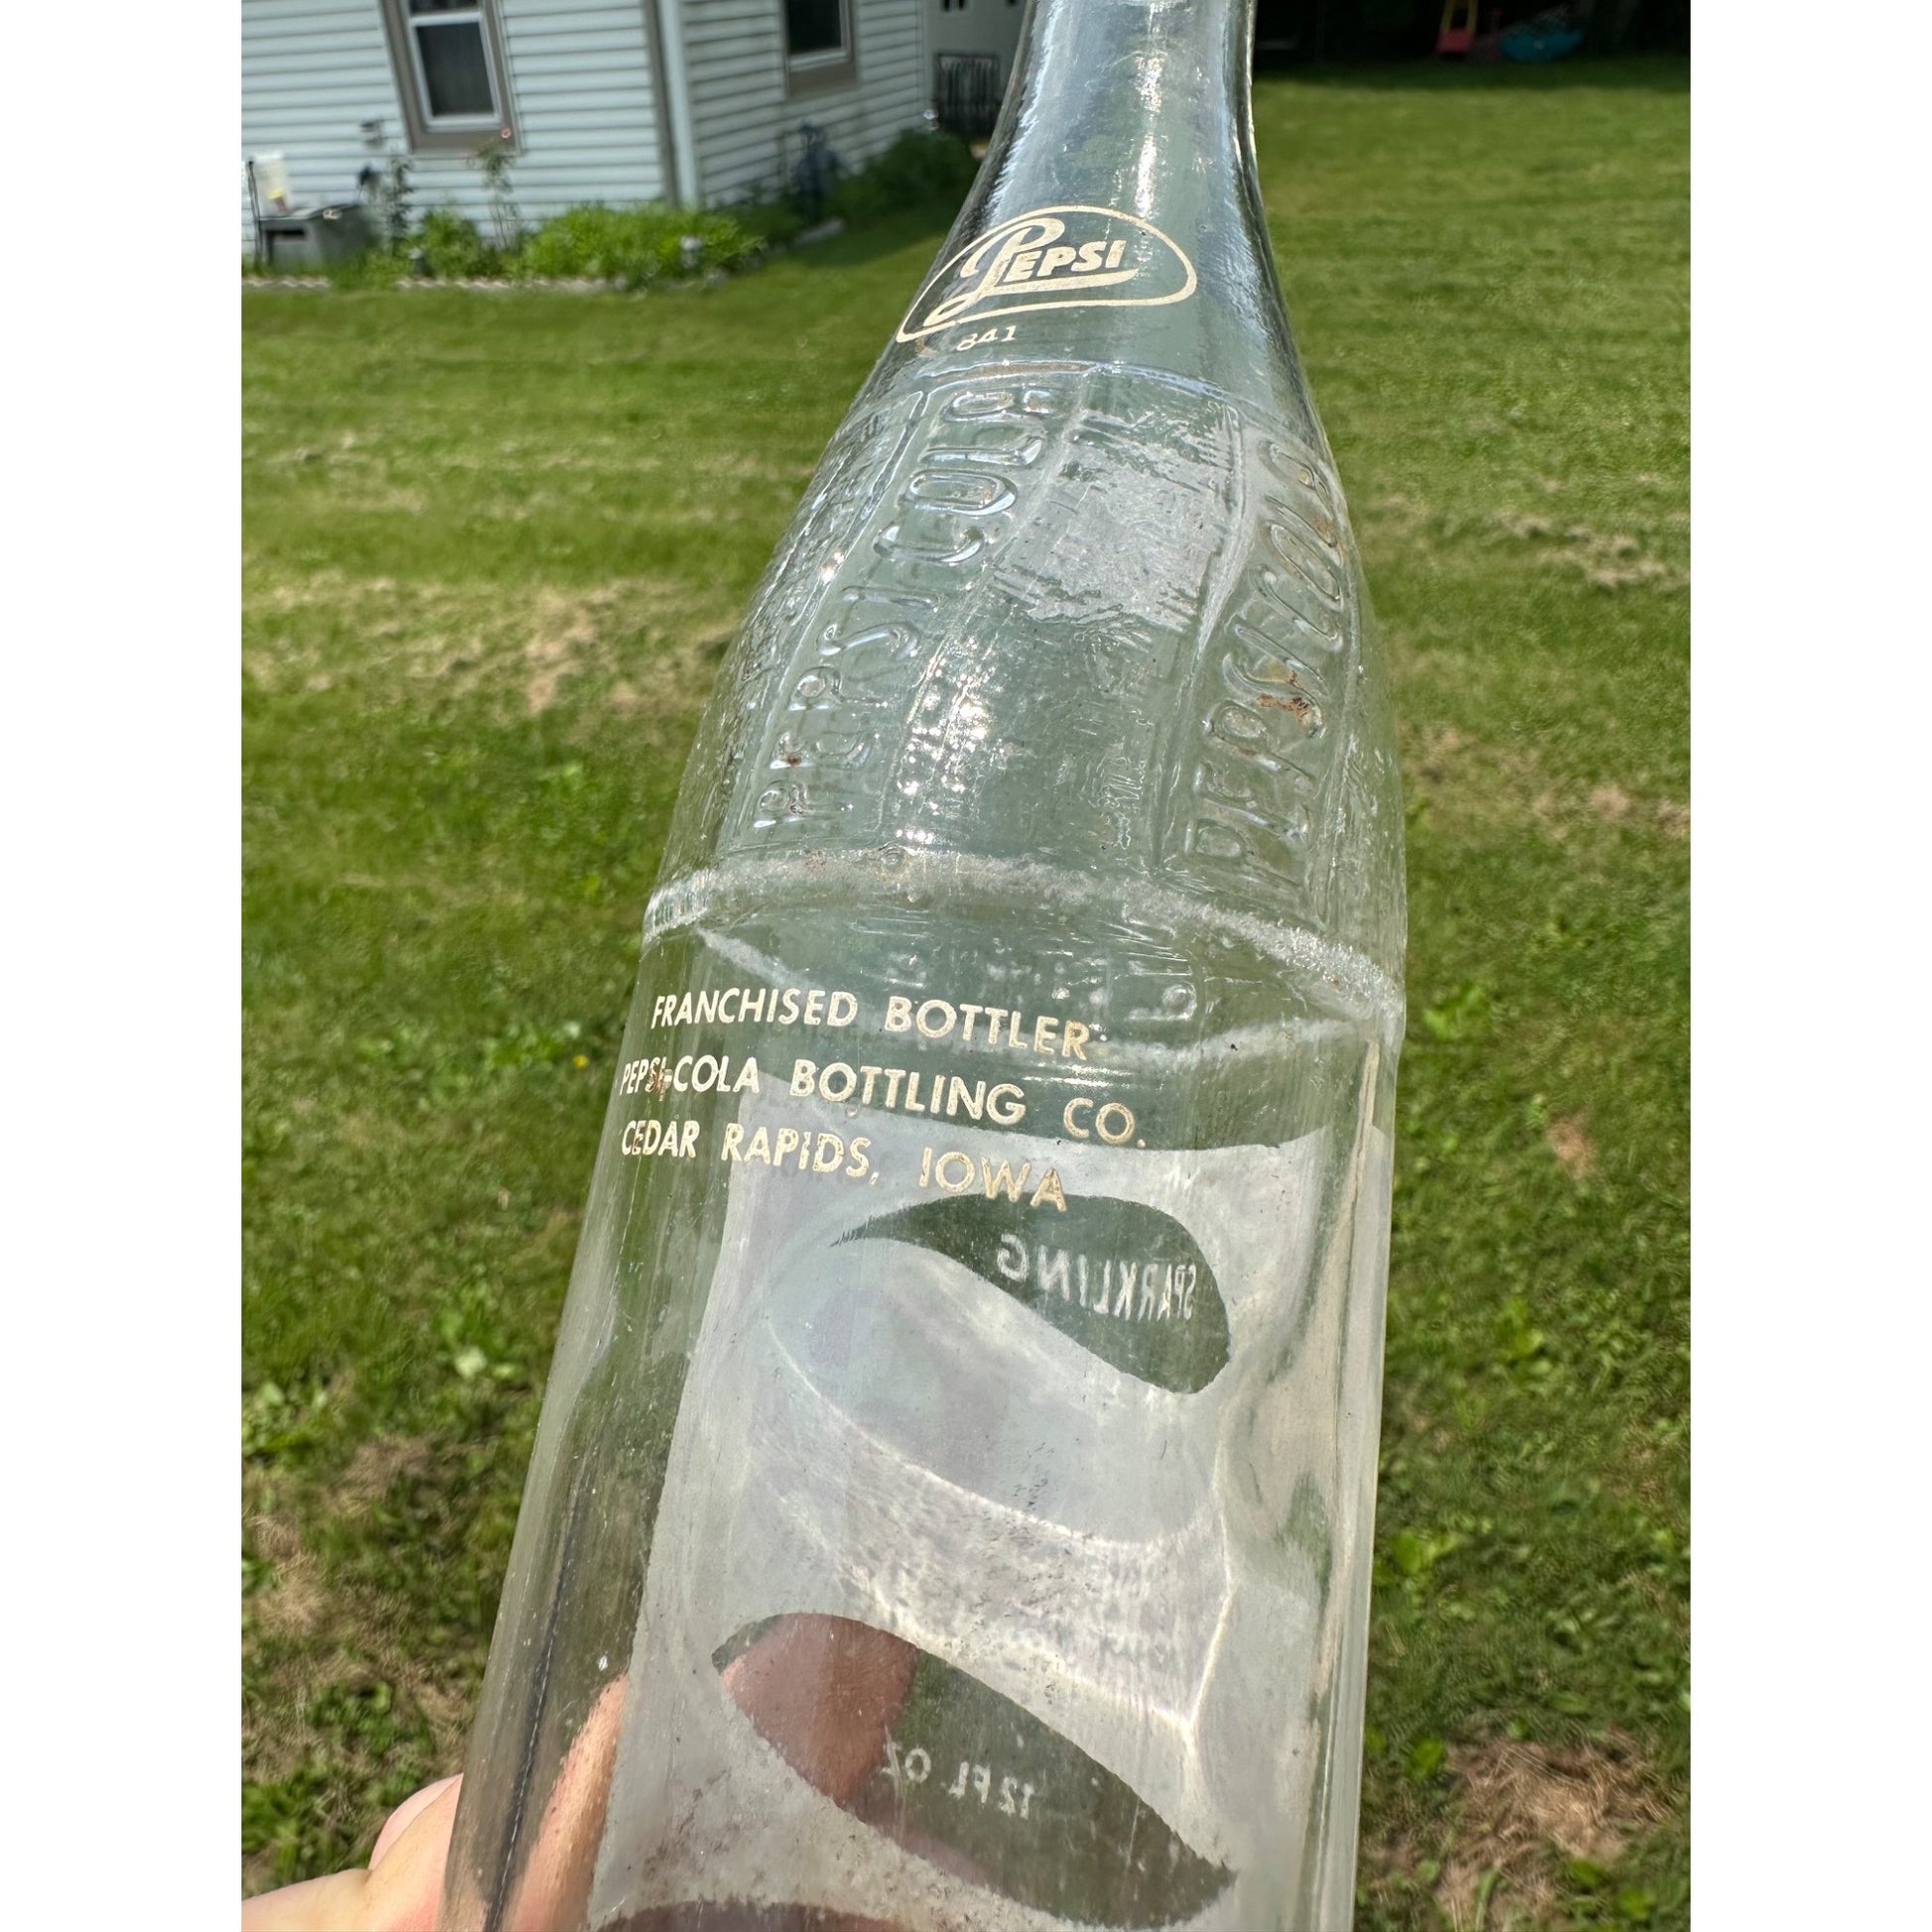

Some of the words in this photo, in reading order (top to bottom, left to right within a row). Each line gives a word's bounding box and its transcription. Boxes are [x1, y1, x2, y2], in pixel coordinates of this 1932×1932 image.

[922, 216, 1141, 328] PEPSI
[956, 325, 1017, 351] 841
[651, 987, 859, 1030] FRANCHISED
[620, 1054, 760, 1101] PEPSI-COLA
[789, 1058, 1027, 1125] BOTTLING
[1063, 1097, 1146, 1148] CO.
[621, 1119, 700, 1159] CEDAR
[721, 1122, 880, 1185] RAPIDS,
[919, 1147, 1067, 1212] IOWA
